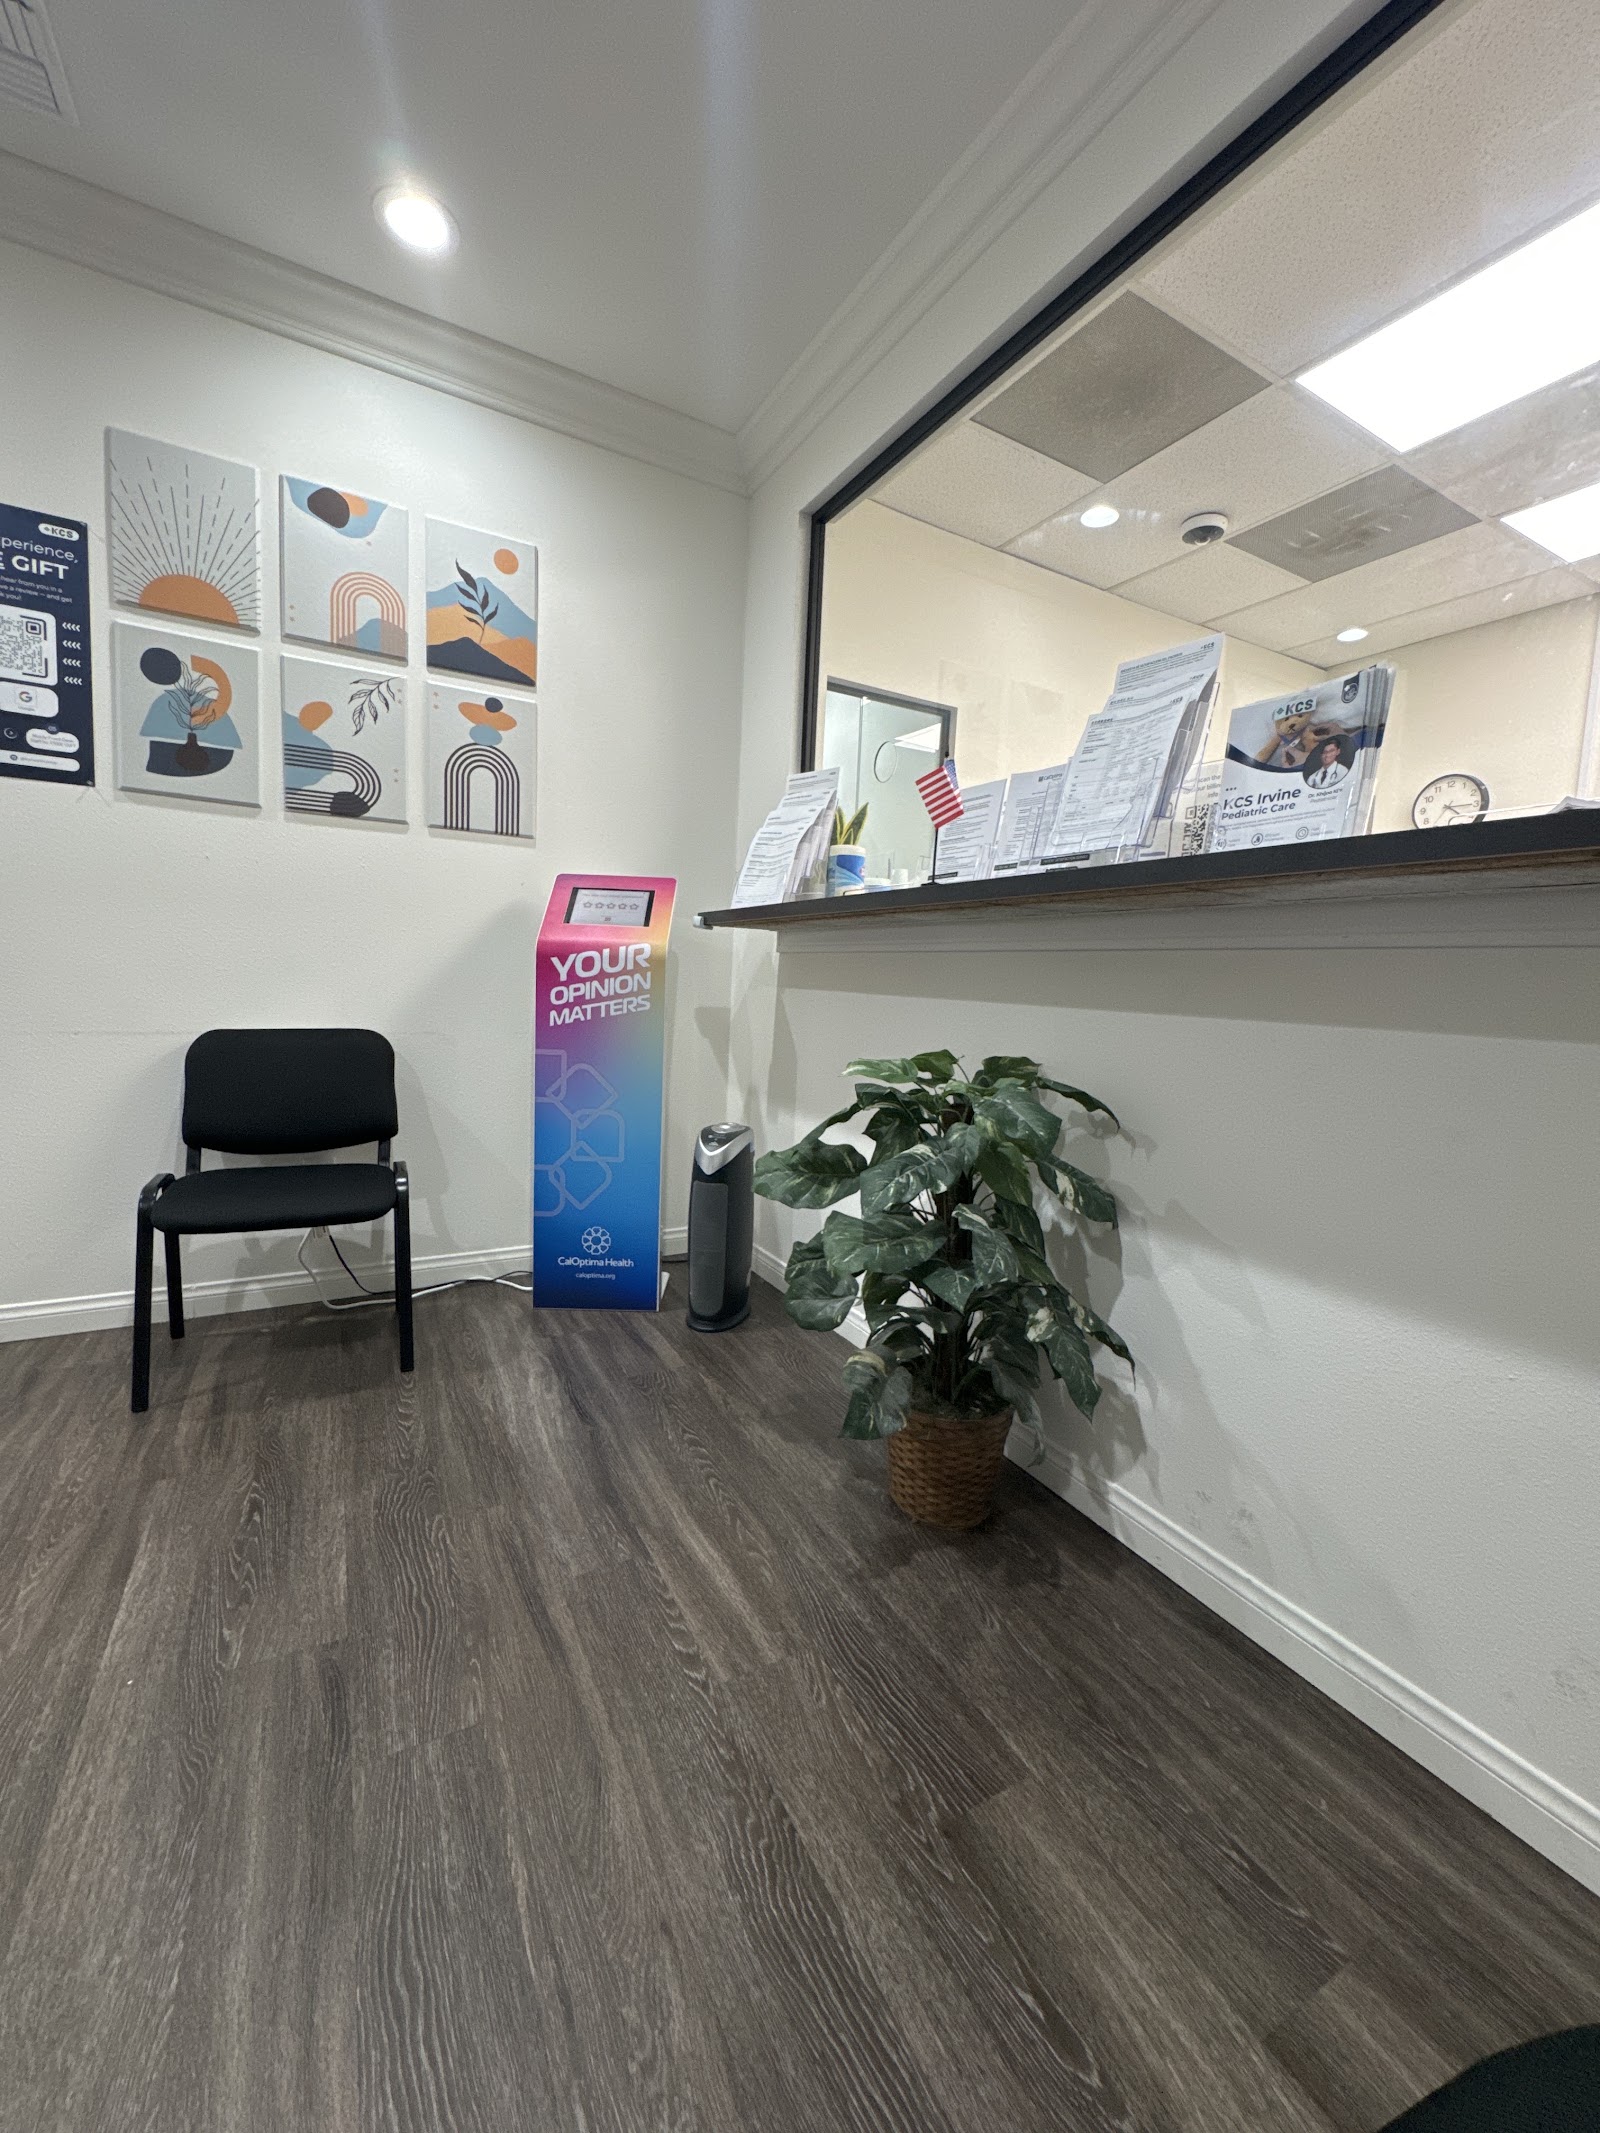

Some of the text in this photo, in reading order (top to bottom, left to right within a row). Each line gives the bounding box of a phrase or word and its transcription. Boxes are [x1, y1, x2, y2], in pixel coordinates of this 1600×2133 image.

[51, 527, 74, 539] KCS
[11, 555, 70, 580] GIFT
[15, 587, 39, 596] review
[46, 592, 60, 600] and
[1285, 698, 1314, 716] KCS
[1434, 786, 1442, 794] 11
[1446, 780, 1456, 788] 12
[1223, 788, 1301, 810] KCS Irvine
[1469, 789, 1477, 797] 2
[1424, 795, 1434, 804] 10
[1472, 800, 1480, 808] 3
[1221, 805, 1268, 820] Pediatric
[1270, 802, 1296, 813] Care
[1420, 807, 1427, 815] 9
[1423, 817, 1429, 825] 8
[550, 943, 651, 982] YOUR
[550, 971, 651, 1006] OPINION
[549, 994, 651, 1027] MATTERS
[557, 1256, 634, 1268] CalOptima Health
[575, 1272, 616, 1281] caloptima.org
